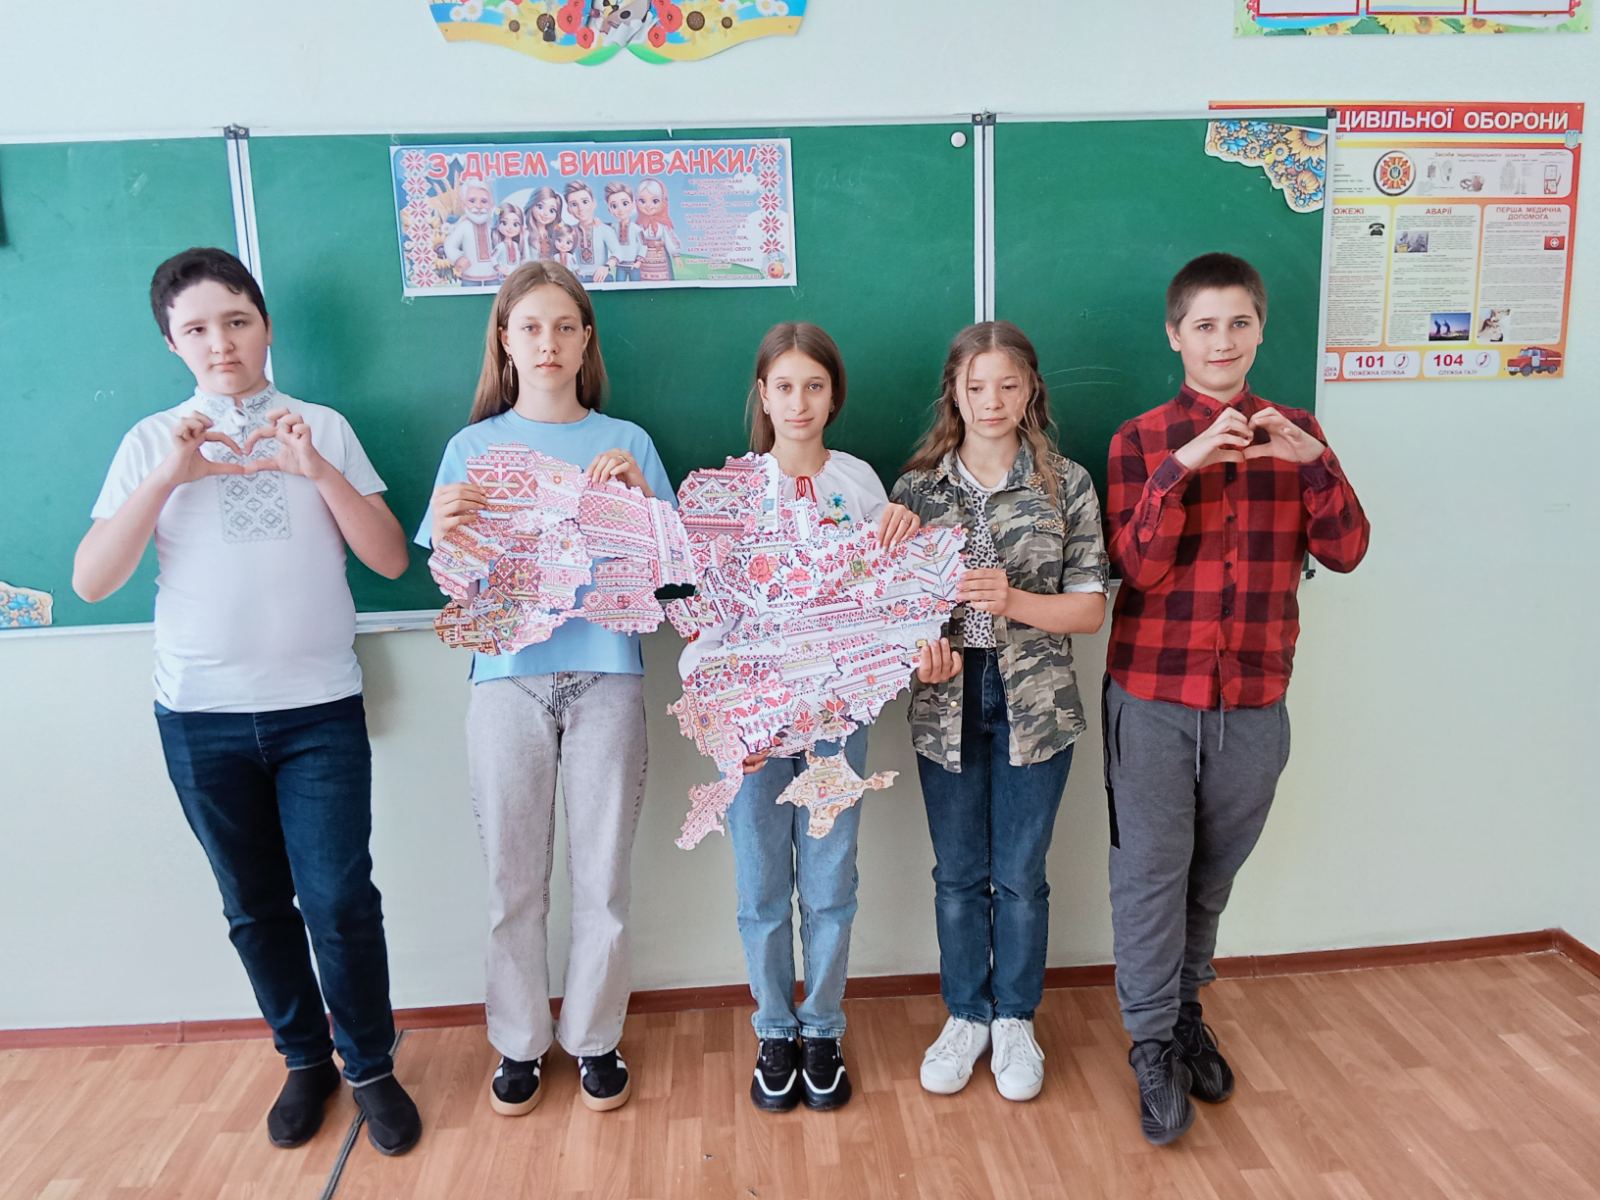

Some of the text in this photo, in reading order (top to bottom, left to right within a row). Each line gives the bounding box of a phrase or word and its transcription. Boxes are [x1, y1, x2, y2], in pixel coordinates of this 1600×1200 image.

[1336, 108, 1569, 131] ЦИВІЛЬНОЇ ОБОРОНИ
[426, 147, 757, 180] З ДНЕМ ВИШИВАНКИ!
[1333, 207, 1365, 215] ОЖЕЖІ
[1507, 213, 1549, 221] ДОПОМОГА
[1355, 355, 1385, 368] 101
[1433, 354, 1464, 367] 104
